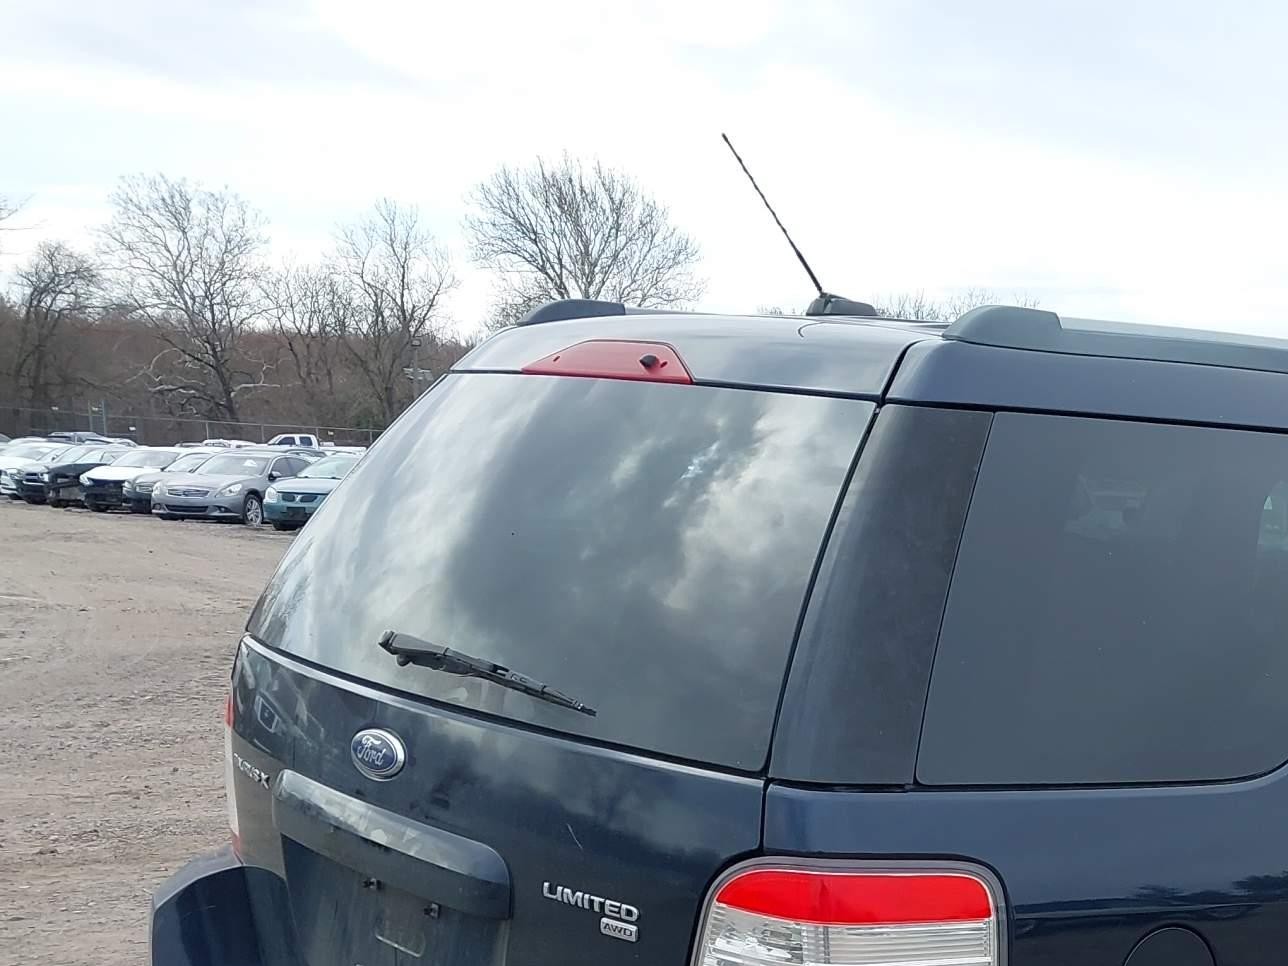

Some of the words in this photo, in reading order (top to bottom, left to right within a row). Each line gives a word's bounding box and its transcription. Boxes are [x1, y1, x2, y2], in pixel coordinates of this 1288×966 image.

[357, 735, 387, 766] Ford
[543, 881, 640, 922] LIMITED
[602, 922, 634, 937] AWD
